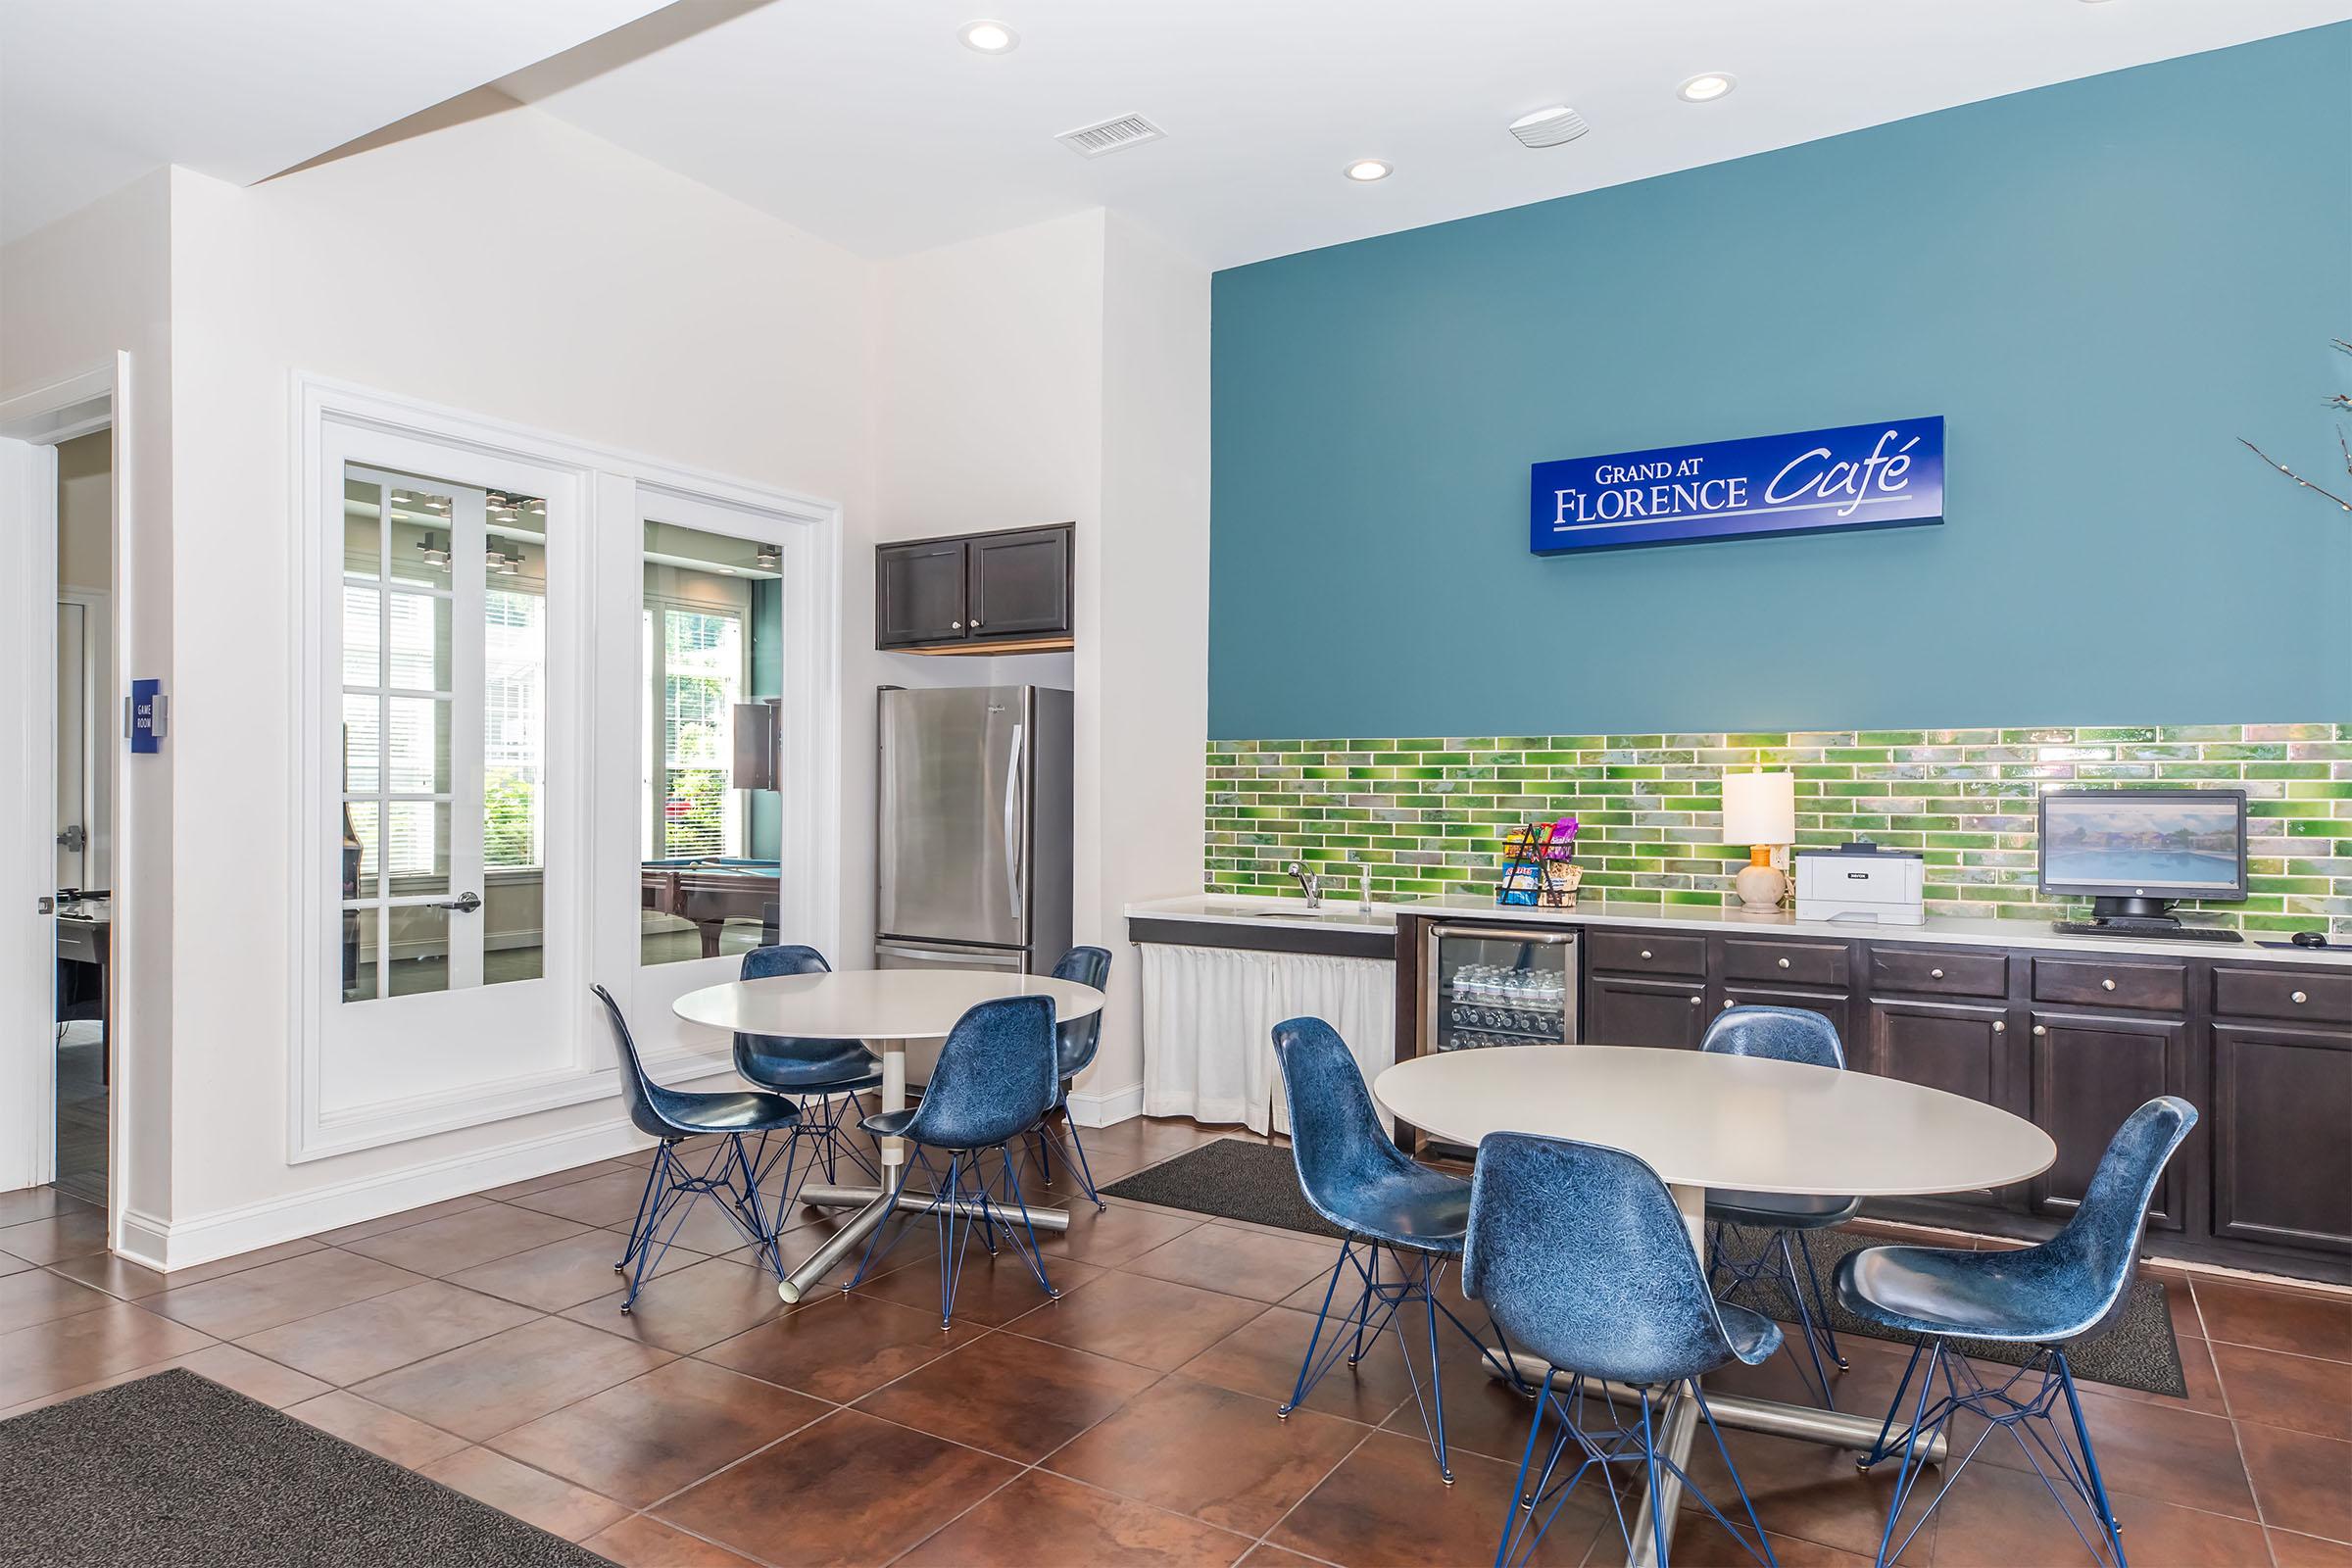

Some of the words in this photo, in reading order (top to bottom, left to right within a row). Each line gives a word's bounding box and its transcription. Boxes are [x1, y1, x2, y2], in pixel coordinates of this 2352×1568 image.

[1553, 478, 1749, 524] FLORENCE
[1764, 429, 1922, 517] Café
[1595, 463, 1672, 485] GRAND
[1676, 457, 1703, 477] AT
[137, 705, 152, 715] GAME
[137, 717, 152, 728] ROOM
